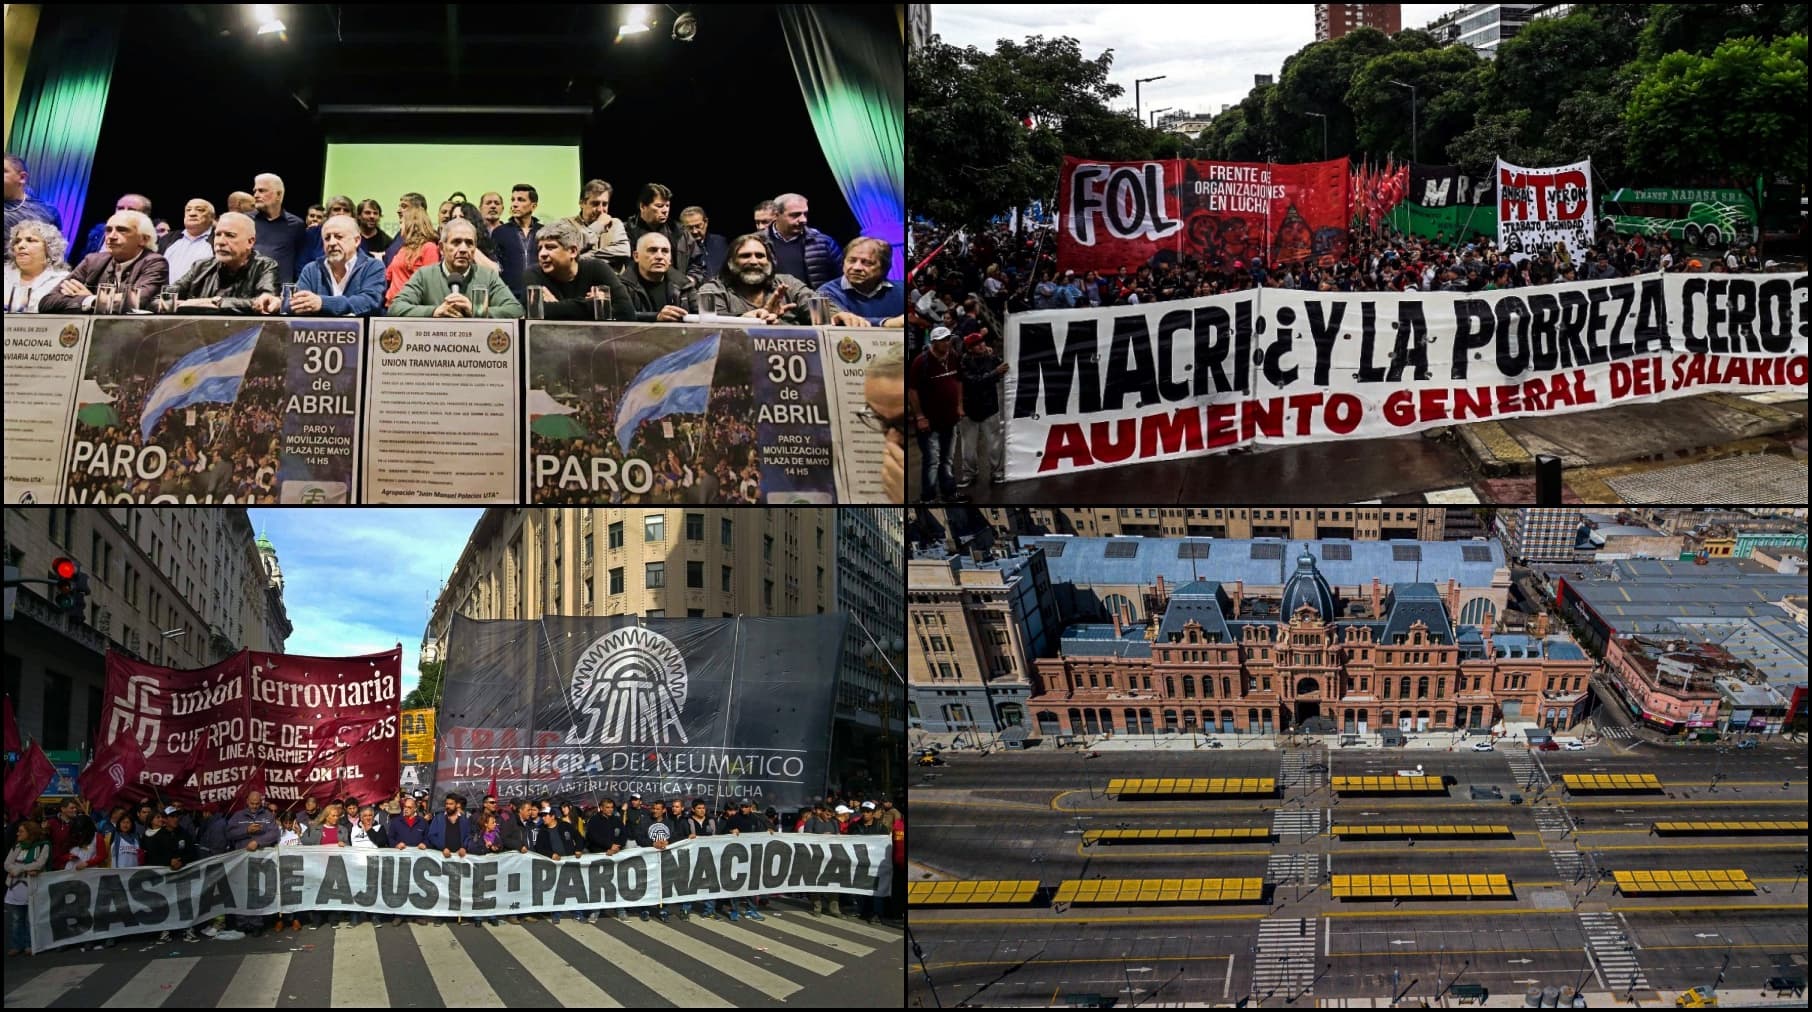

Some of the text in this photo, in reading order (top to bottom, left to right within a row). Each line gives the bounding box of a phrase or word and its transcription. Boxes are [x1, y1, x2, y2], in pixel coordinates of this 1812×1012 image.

[1209, 165, 1259, 182] FRENTE
[1194, 181, 1286, 199] ORGANIZACIONES
[1500, 168, 1588, 221] MTD
[1069, 163, 1184, 246] FOL
[1209, 195, 1270, 215] EN LUCHA
[293, 330, 356, 344] MARTES
[1353, 300, 1428, 383] LA
[1451, 279, 1674, 380] POBREZA
[12, 338, 53, 347] NACIONAL
[406, 343, 481, 353] PARO NACIONAL
[753, 338, 817, 352] MARTES
[4, 353, 74, 362] VIARIA AUTOMOTOR
[303, 346, 344, 374] 30
[381, 358, 508, 369] UNION TRANVIARIA AUTOMOTOR
[768, 354, 807, 383] 30
[843, 368, 865, 377] UNIO
[312, 377, 331, 391] de
[780, 386, 799, 400] de
[285, 394, 355, 415] ABRIL
[758, 404, 829, 424] ABRIL
[1037, 392, 1363, 473] AUMENTO
[1382, 369, 1598, 427] GENERAL
[1609, 356, 1666, 398] DEL
[303, 424, 336, 434] PARO Y
[286, 435, 351, 446] MOVILIZACION
[778, 435, 811, 444] PARO Y
[285, 446, 351, 456] PLAZA DE MAYO
[763, 446, 829, 455] MOVILIZACION
[71, 440, 168, 480] PARO
[306, 457, 329, 465] 14 HS
[763, 456, 830, 466] PLAZA DE MAYO
[535, 453, 654, 494] PARO
[785, 467, 809, 476] 14 HS
[171, 665, 396, 716] unión ferroviaria
[565, 680, 689, 745] SUTNA
[250, 718, 276, 745] DE
[219, 742, 256, 761] LINEA
[453, 752, 804, 778] LISTA NEGRA DEL NEUMATICO
[139, 771, 174, 787] POR
[336, 765, 364, 780] DEL
[498, 782, 552, 797] LASISTA,
[685, 782, 693, 793] Y
[698, 783, 714, 797] DE
[718, 784, 763, 798] LUCHA
[47, 863, 237, 943] BASTA
[246, 854, 306, 911] DE
[531, 856, 648, 906] PARO
[661, 839, 879, 899] NACIONAL
